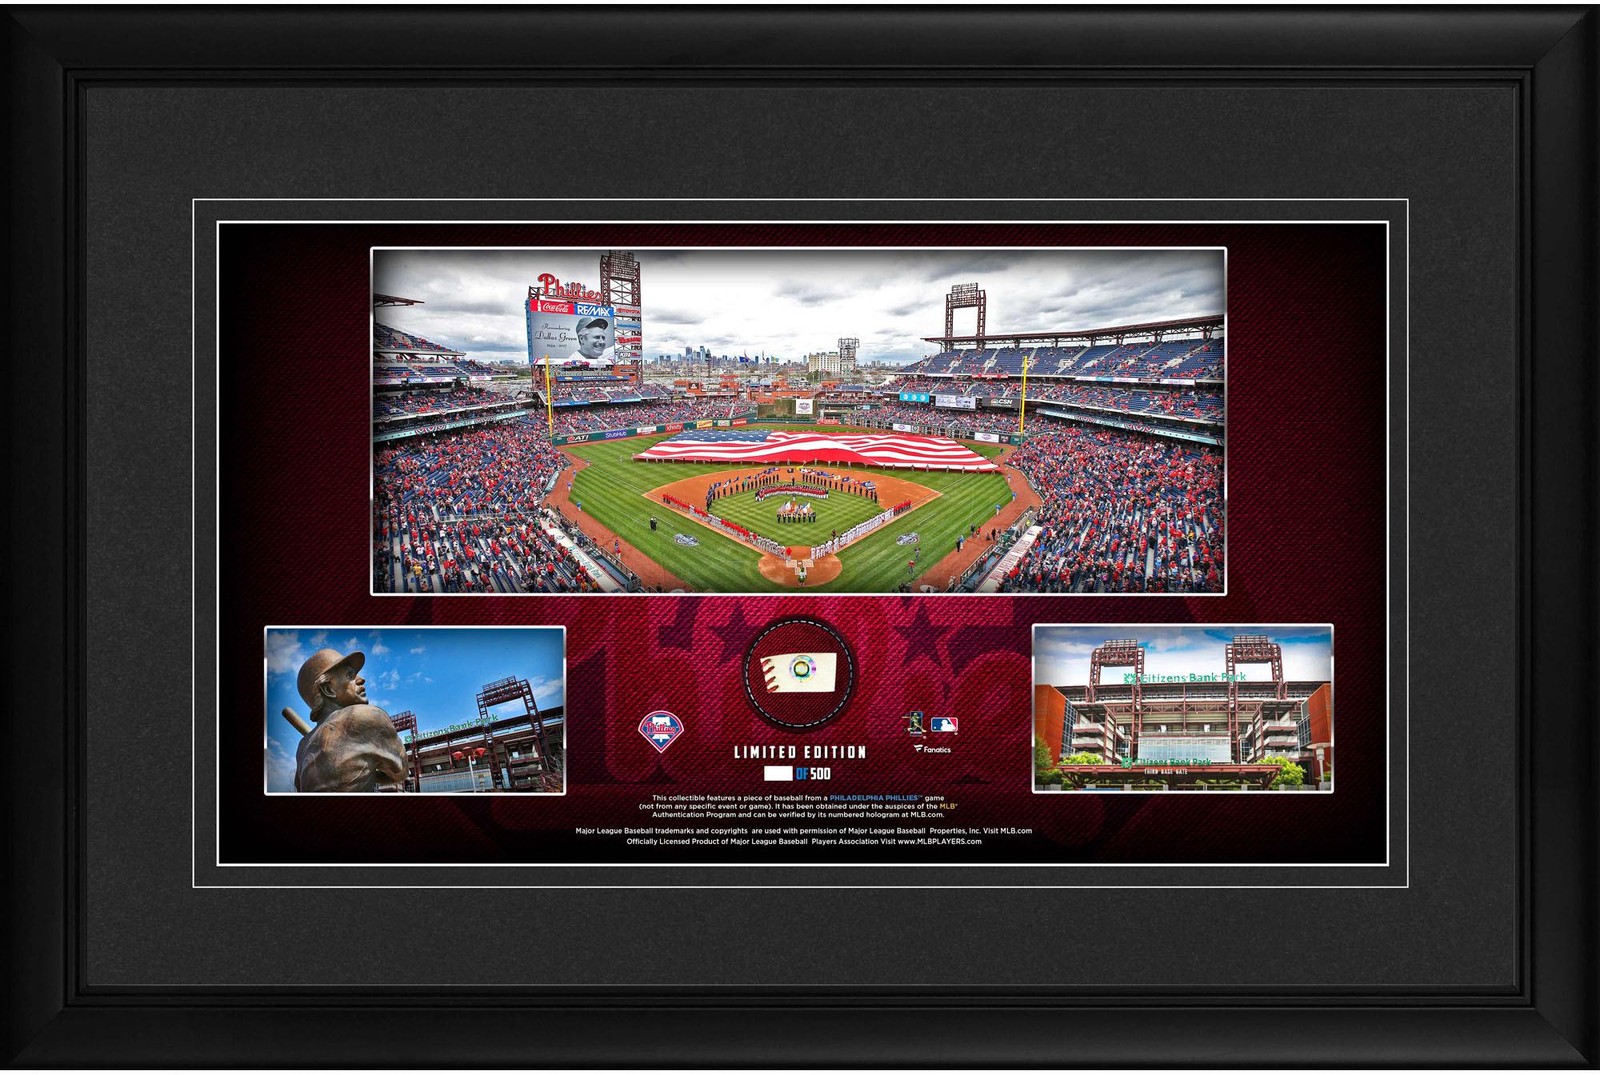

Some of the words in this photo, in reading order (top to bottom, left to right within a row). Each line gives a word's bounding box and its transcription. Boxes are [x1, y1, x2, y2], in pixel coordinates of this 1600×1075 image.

[537, 273, 603, 300] Phillies
[577, 304, 611, 317] RE/MAX
[1140, 673, 1186, 683] Citizens
[1189, 672, 1218, 682] Bank
[449, 720, 473, 731] Bank
[734, 745, 796, 759] LIMITED
[804, 745, 866, 759] EDITION
[1169, 758, 1191, 766] Bank
[1192, 758, 1212, 766] Park
[795, 767, 809, 780] OF
[810, 767, 831, 780] 500
[743, 795, 763, 803] piece
[639, 803, 654, 811] (not
[689, 803, 716, 811] specific
[748, 803, 773, 811] game).
[885, 803, 915, 811] auspices
[706, 811, 736, 819] Program
[807, 811, 816, 819] by
[866, 811, 900, 819] hologram
[576, 827, 595, 836] Major
[597, 827, 622, 836] League
[711, 827, 748, 836] copyrights
[800, 827, 837, 836] permission
[848, 827, 867, 836] Major
[869, 827, 895, 836] League
[930, 827, 967, 836] Properties,
[627, 838, 658, 846] Officially
[730, 838, 750, 846] Major
[752, 838, 777, 846] League
[812, 838, 837, 846] Players
